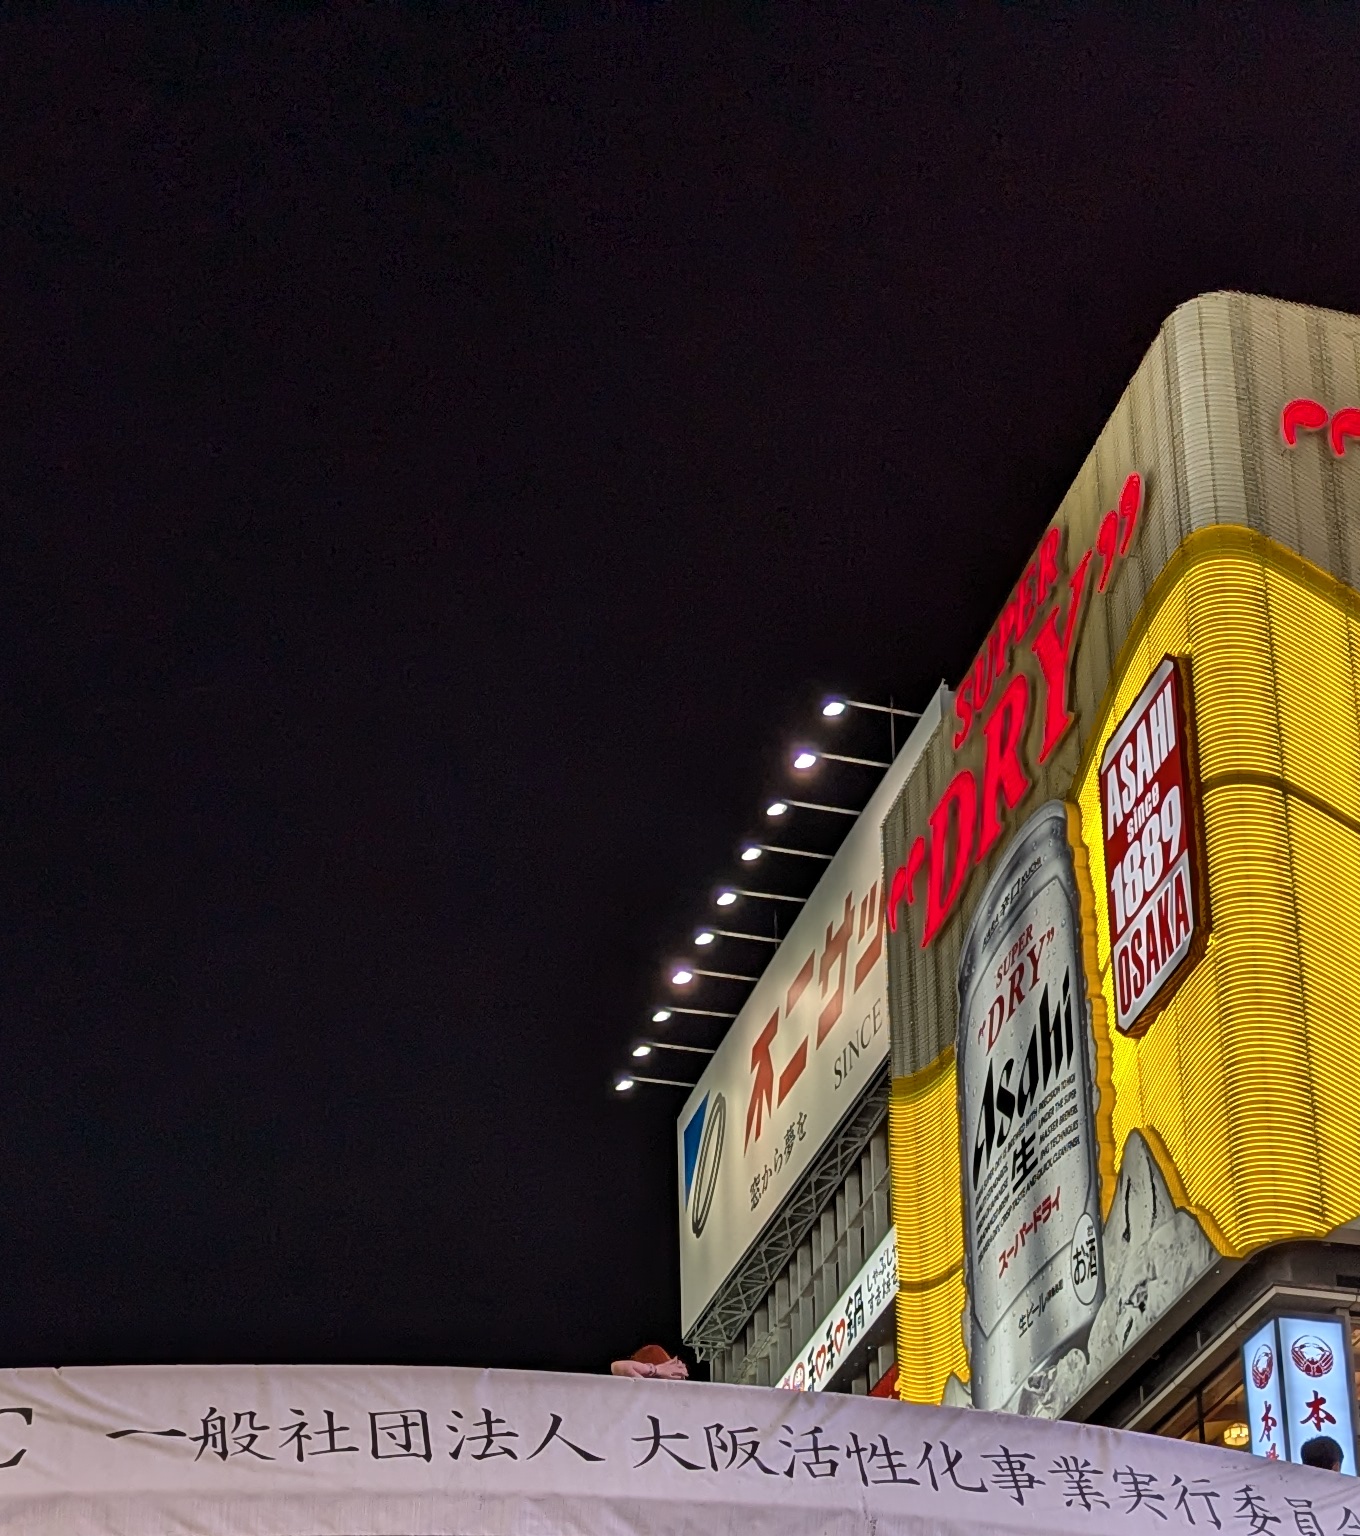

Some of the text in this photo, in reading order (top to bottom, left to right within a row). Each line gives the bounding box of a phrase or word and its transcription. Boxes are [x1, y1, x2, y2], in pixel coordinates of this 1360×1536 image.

[953, 526, 1061, 750] SUPER
[1107, 679, 1176, 841] ASAHI
[1126, 781, 1159, 844] since
[1110, 784, 1182, 936] 1889
[995, 923, 1034, 990] SUPER
[1116, 865, 1190, 1020] OSAKA
[834, 997, 883, 1091] SINCE
[973, 965, 1074, 1192] Asahi
[1011, 1131, 1039, 1195] 生
[998, 1185, 1061, 1280] スーパードライ
[104, 1404, 608, 1466] 一般社団法人
[1300, 1390, 1337, 1432] 本
